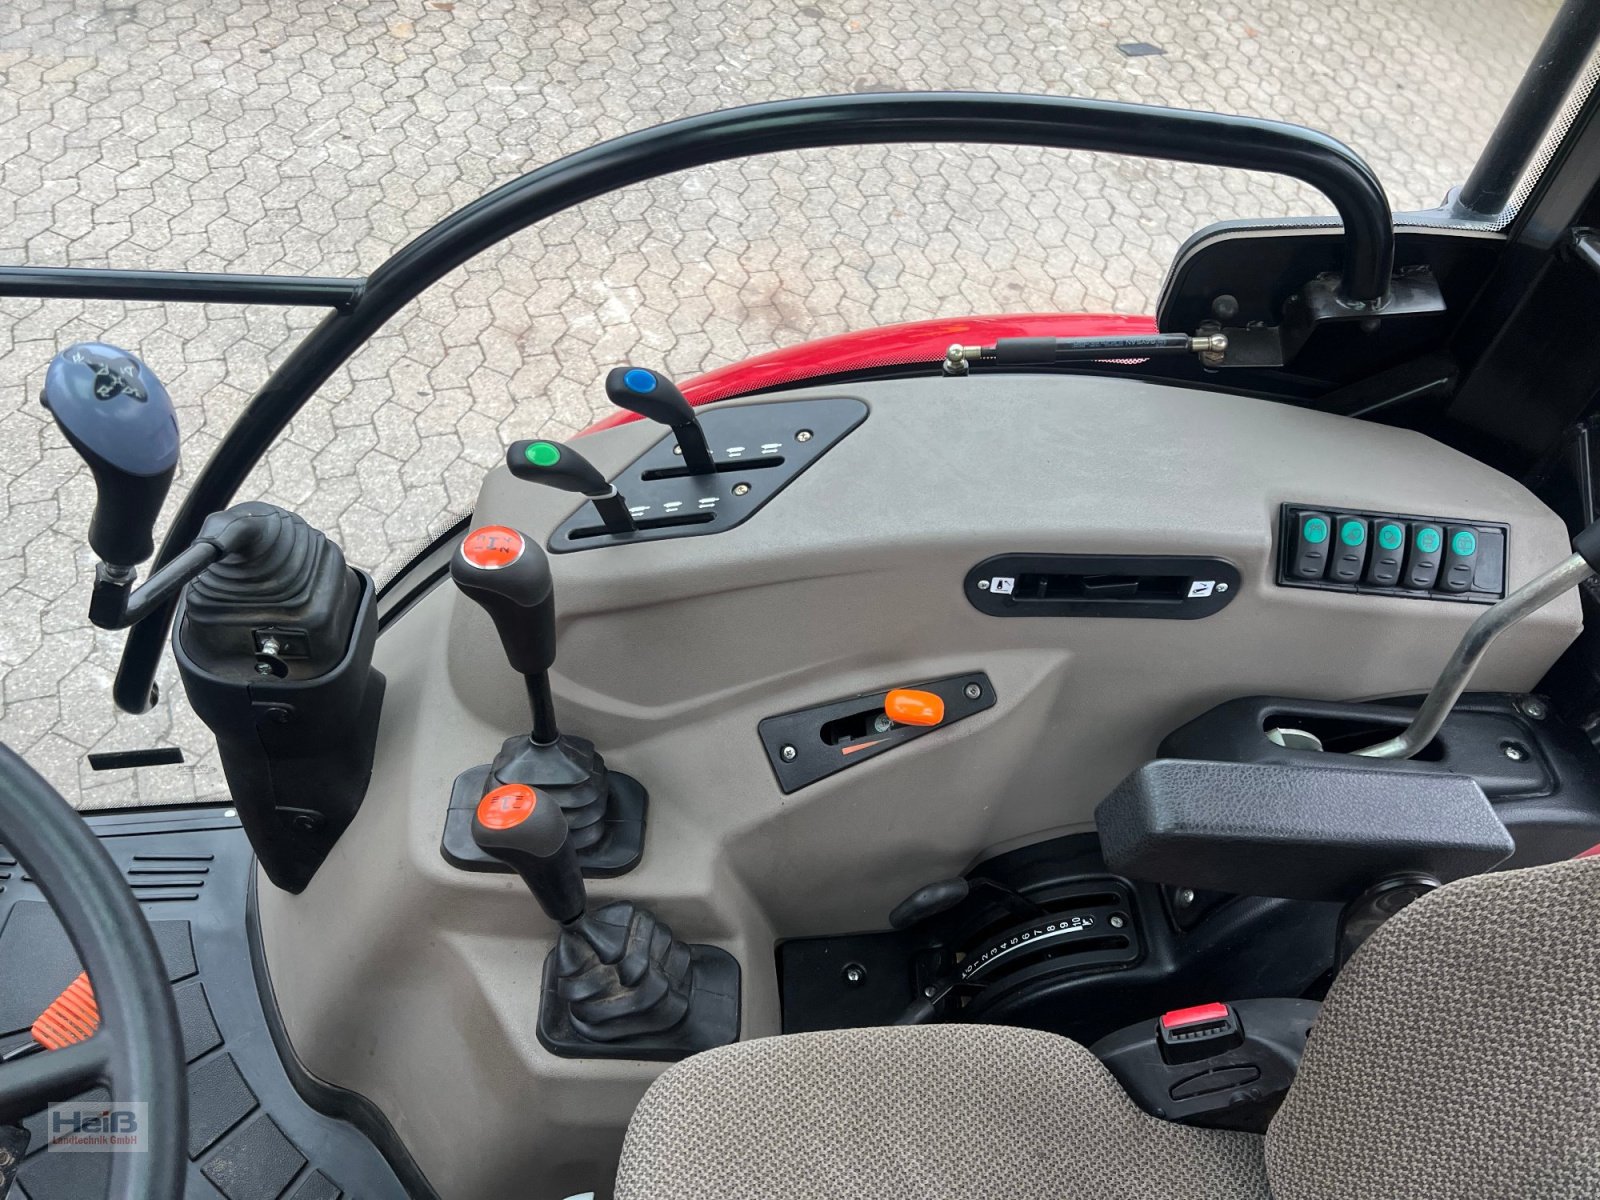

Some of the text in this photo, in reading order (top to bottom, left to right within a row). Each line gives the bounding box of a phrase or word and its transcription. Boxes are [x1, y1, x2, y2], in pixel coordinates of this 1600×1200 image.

[1010, 937, 1019, 945] 5
[1021, 932, 1030, 940] 6
[1046, 924, 1056, 932] 8
[1059, 921, 1069, 929] 9
[1071, 917, 1081, 927] 10
